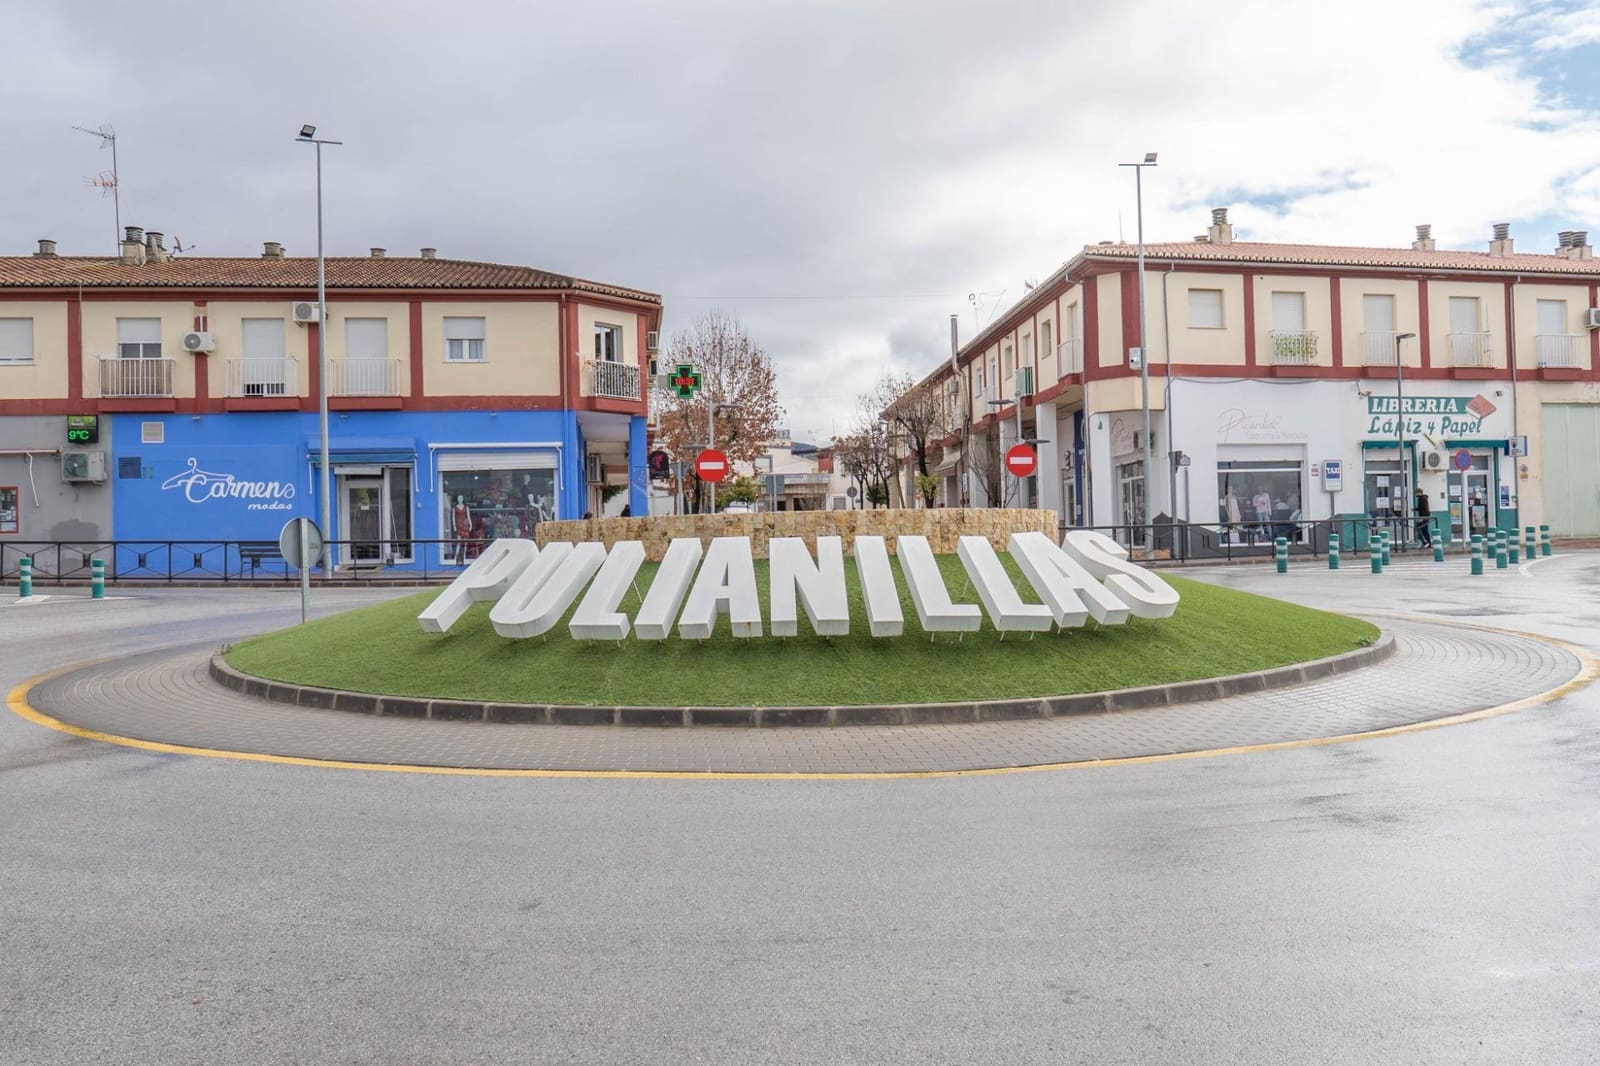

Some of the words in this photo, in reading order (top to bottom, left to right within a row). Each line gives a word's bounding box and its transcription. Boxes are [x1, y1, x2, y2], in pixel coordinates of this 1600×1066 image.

[1371, 398, 1458, 413] LIBRERIA
[1368, 416, 1422, 437] Lápiz
[1427, 420, 1436, 436] y
[1441, 416, 1482, 437] Papel
[180, 474, 295, 503] Carmen
[247, 501, 293, 511] modas
[417, 530, 1180, 641] PULIANILLAS
